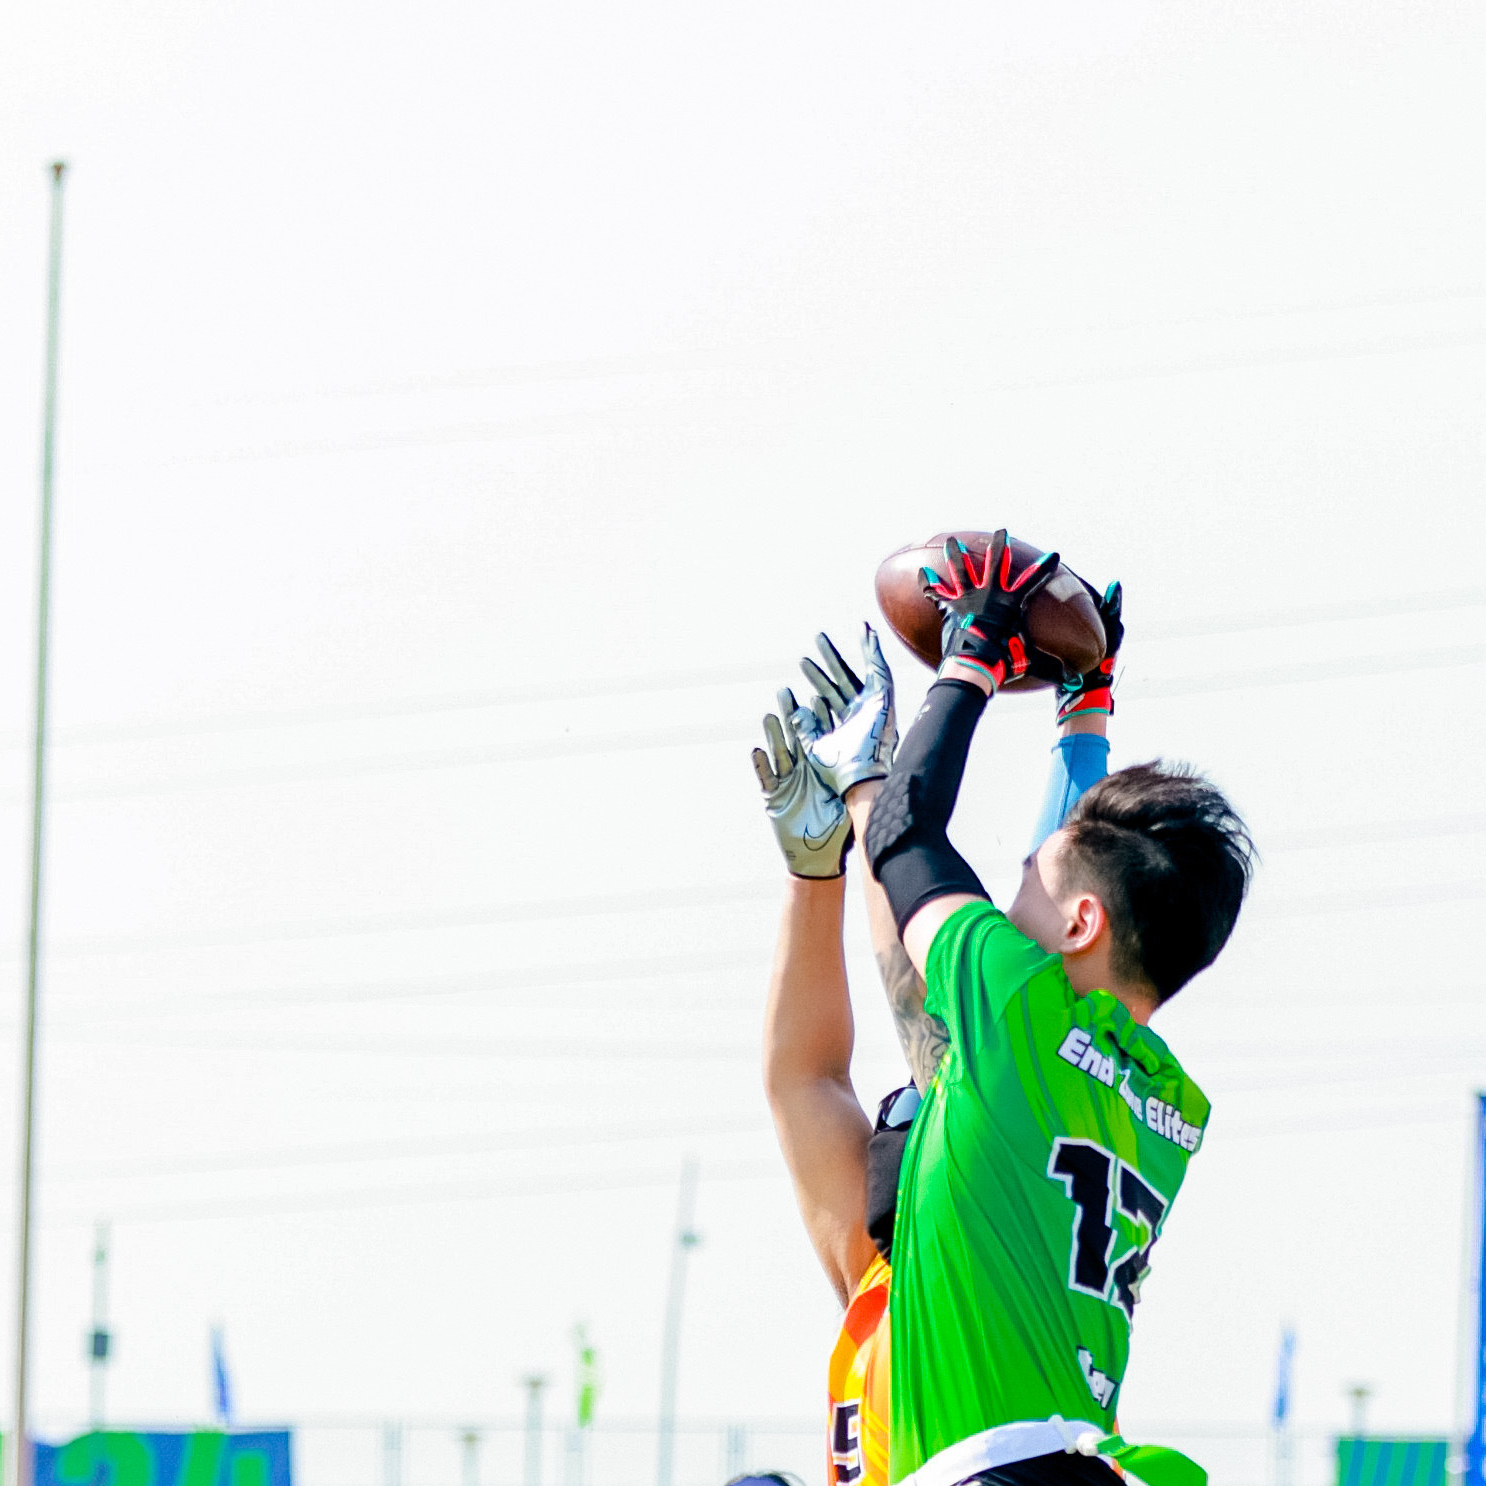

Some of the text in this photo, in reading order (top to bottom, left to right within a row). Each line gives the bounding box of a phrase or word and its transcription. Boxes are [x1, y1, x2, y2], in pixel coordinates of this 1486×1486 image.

[1057, 1025, 1115, 1088] End
[1145, 1096, 1203, 1153] Elites
[832, 1399, 867, 1486] 5
